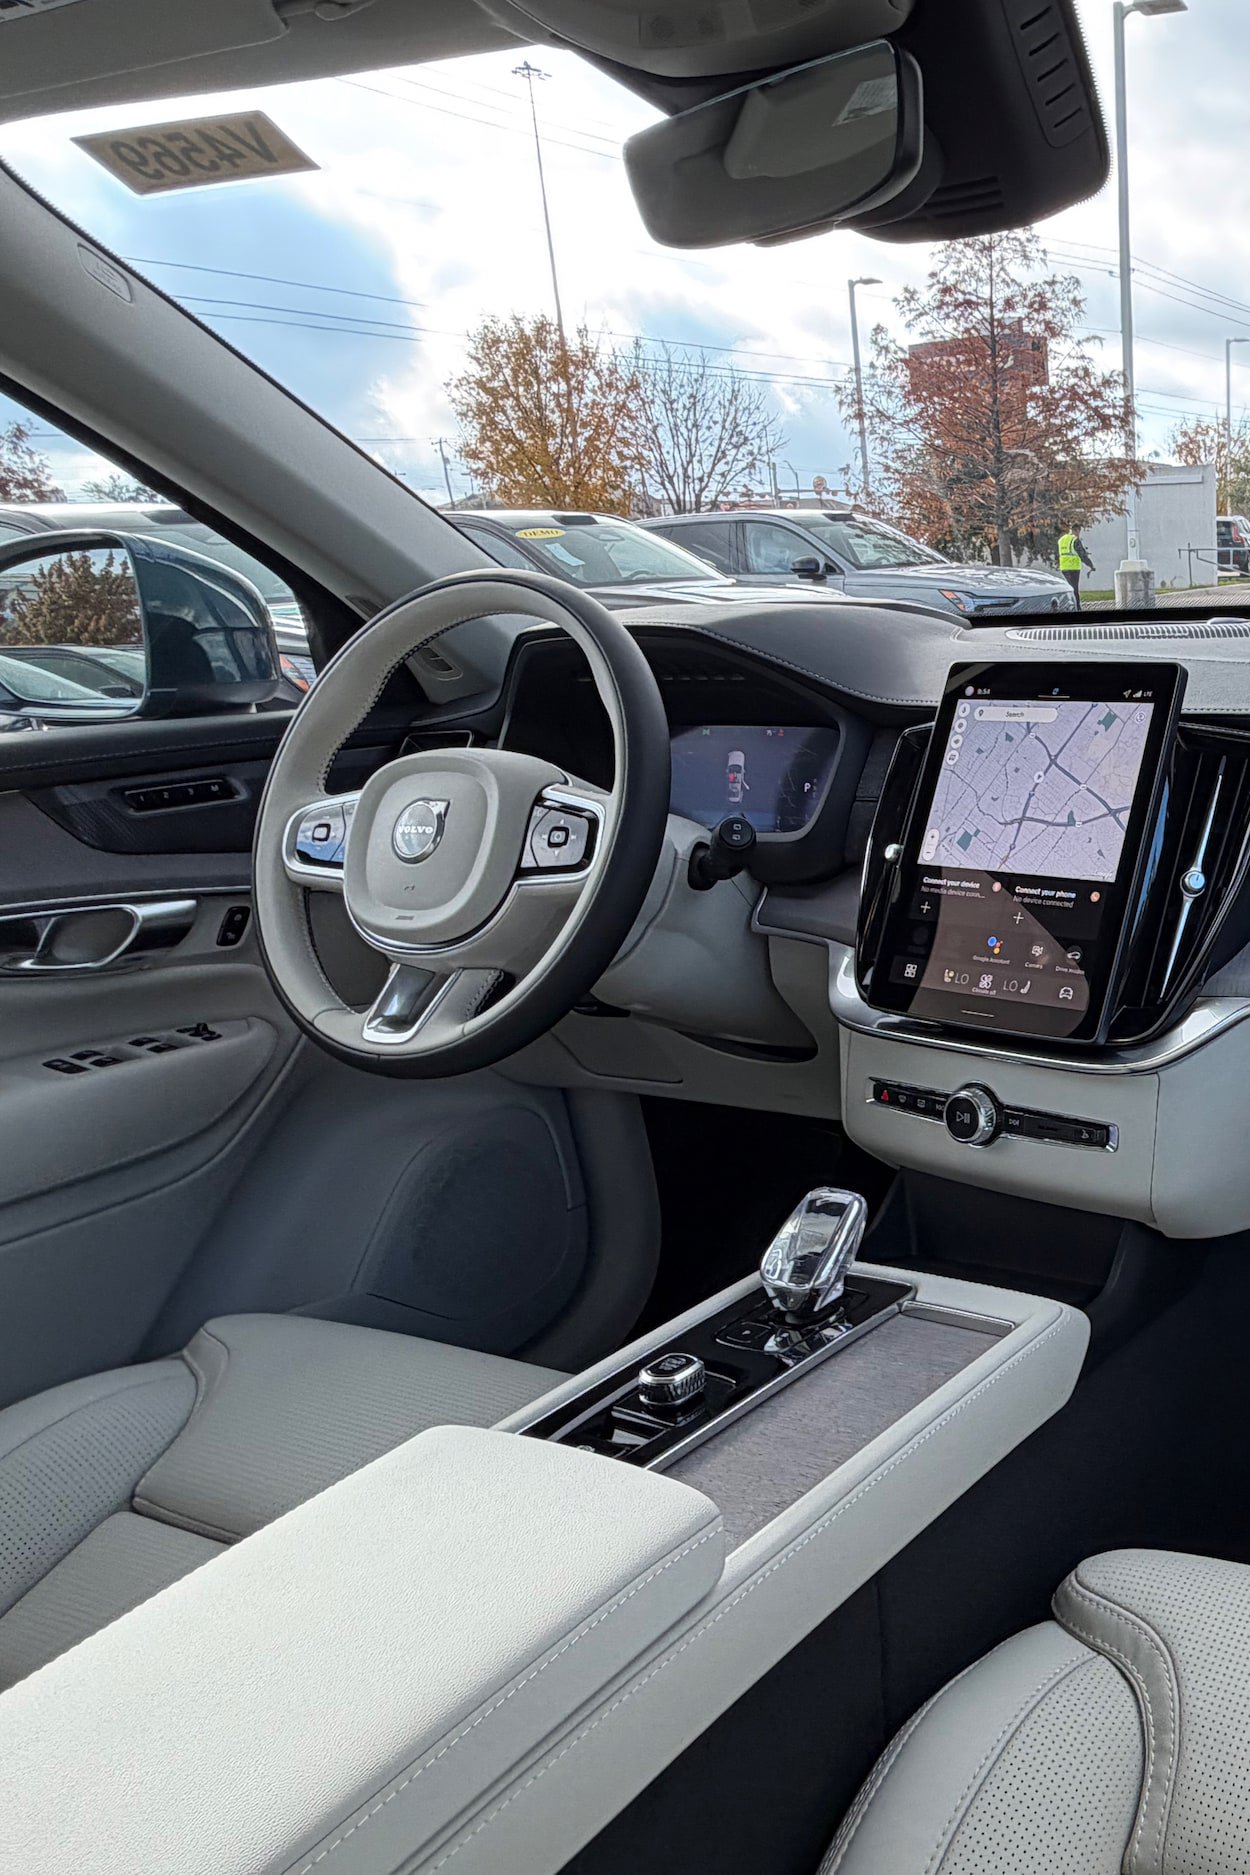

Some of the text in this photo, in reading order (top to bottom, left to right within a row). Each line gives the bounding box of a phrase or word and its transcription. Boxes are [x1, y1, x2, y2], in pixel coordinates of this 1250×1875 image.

[523, 529, 560, 537] DEMO
[804, 782, 811, 792] P
[398, 825, 434, 834] VOLVO
[922, 876, 980, 889] Connect your device
[1015, 886, 1077, 899] Connect your phone
[1024, 896, 1042, 905] device
[1042, 898, 1075, 908] connected
[955, 972, 970, 985] LO
[1003, 979, 1019, 992] LO
